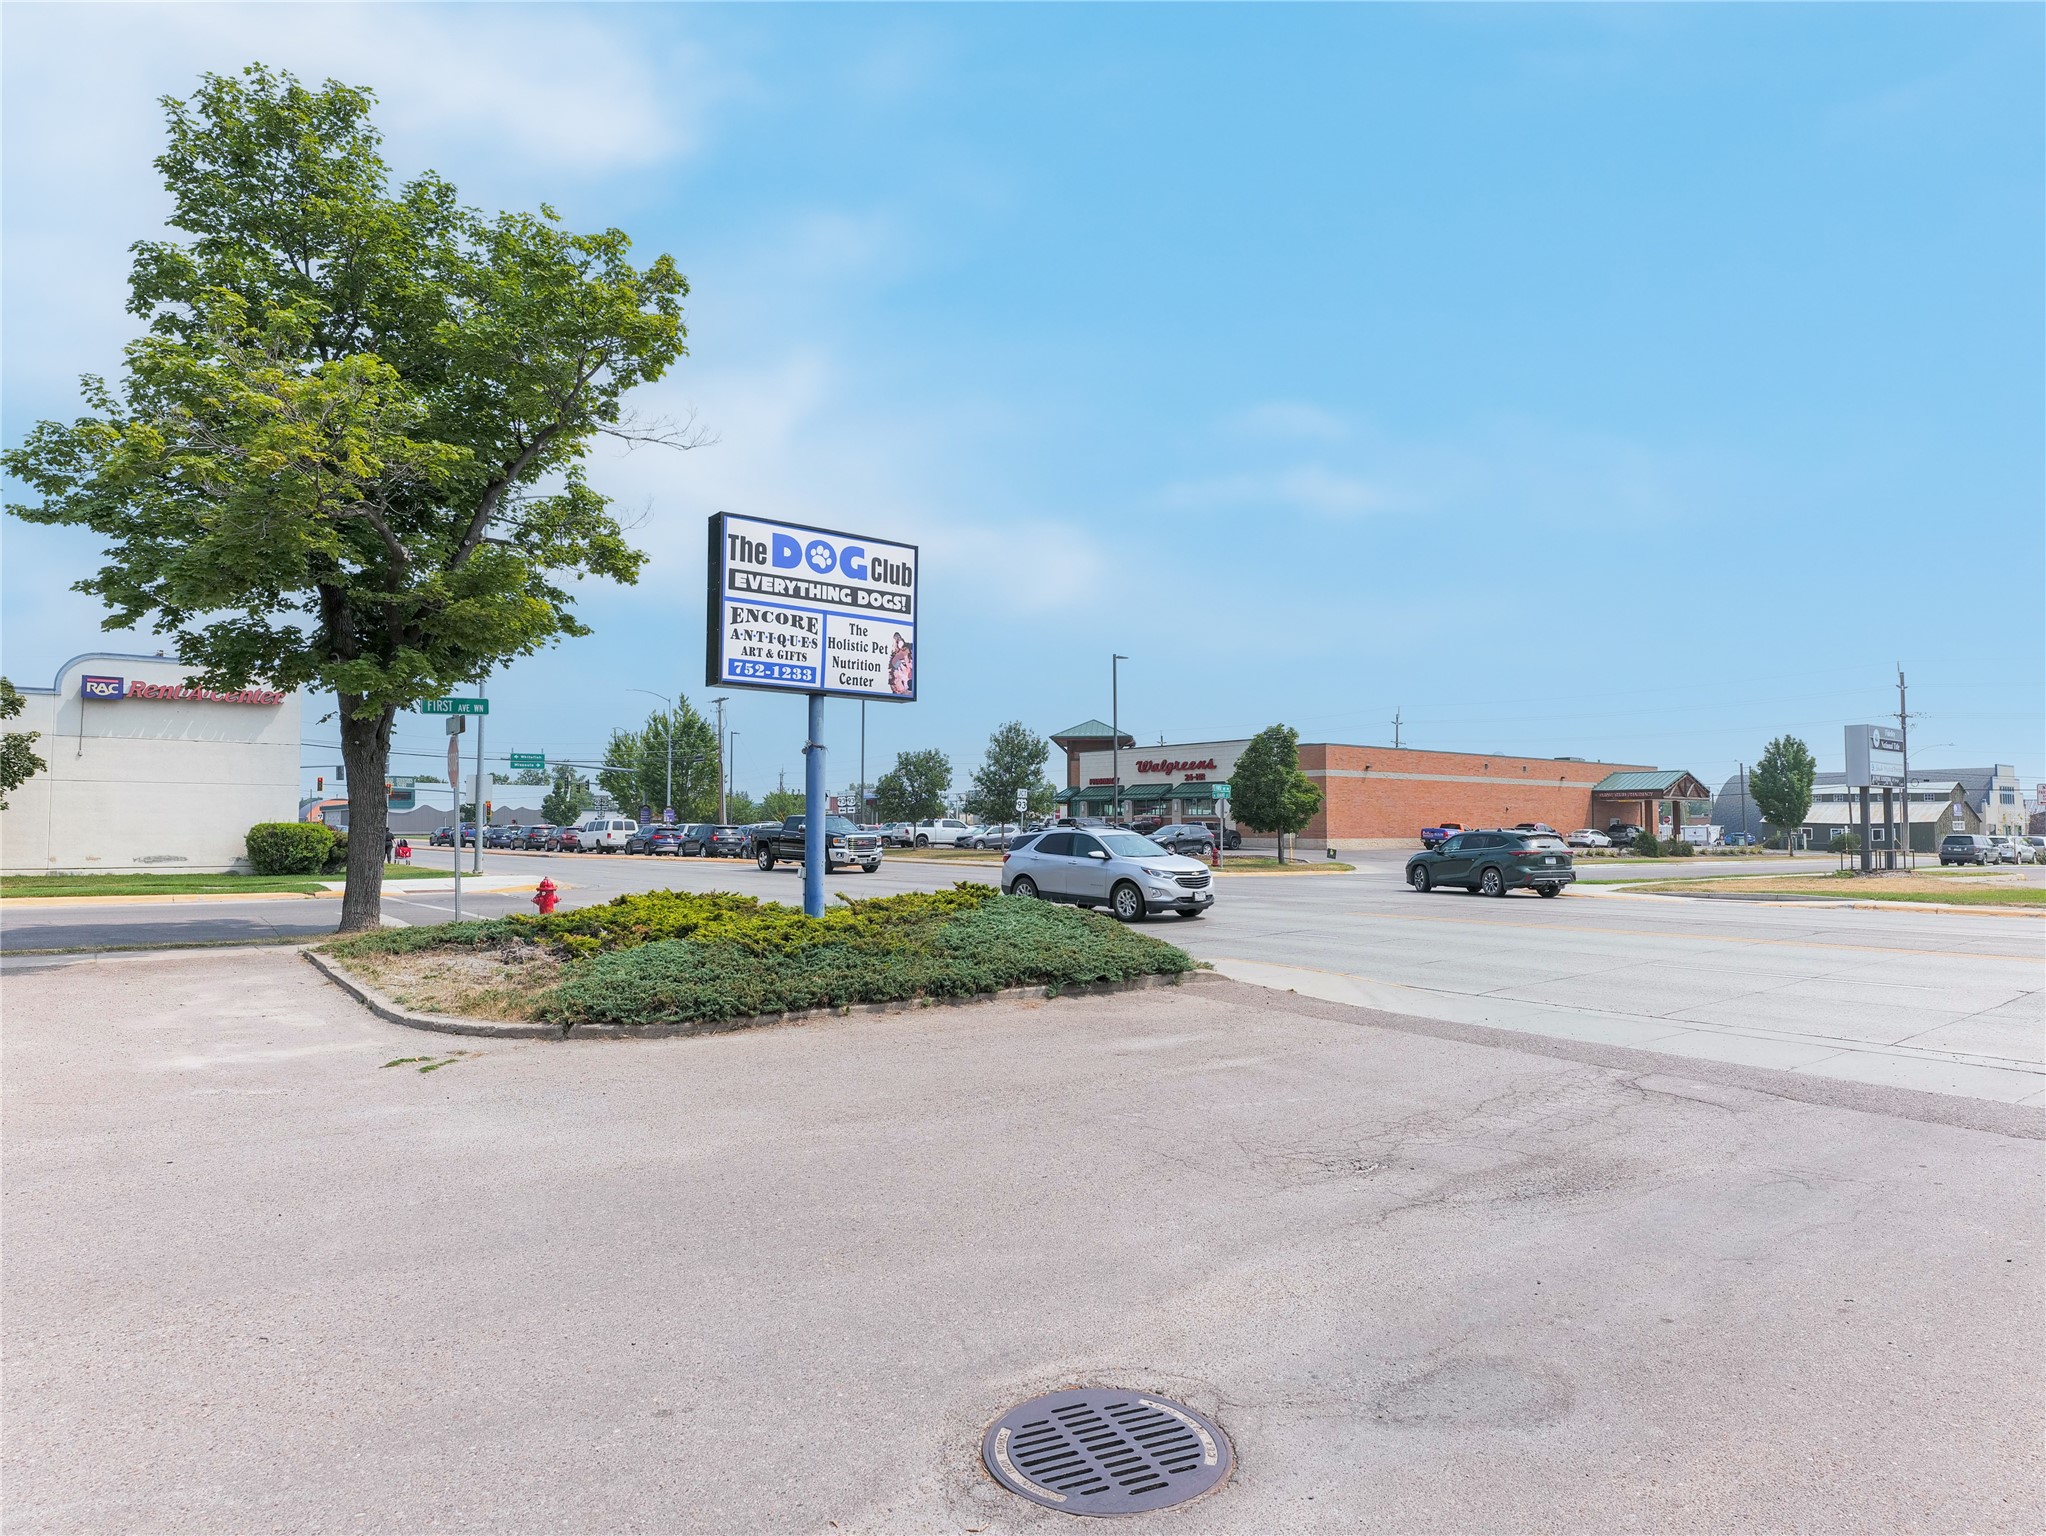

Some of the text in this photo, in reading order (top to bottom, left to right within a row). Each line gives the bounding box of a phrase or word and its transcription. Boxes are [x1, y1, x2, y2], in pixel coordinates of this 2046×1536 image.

[728, 532, 913, 587] The DOG Club
[734, 572, 907, 611] EVERYTHING DOGS!
[730, 606, 819, 635] ENCORE
[849, 622, 869, 637] The
[741, 646, 808, 662] ART & GIFTS
[828, 637, 889, 655] Holistic Pet
[733, 662, 813, 681] 752-1233
[832, 655, 881, 672] Nutrition
[839, 672, 874, 687] Center
[86, 682, 119, 695] RAC
[427, 700, 484, 712] FIRST AVE WN
[1135, 758, 1217, 776] Walgreens
[1017, 800, 1027, 809] 93
